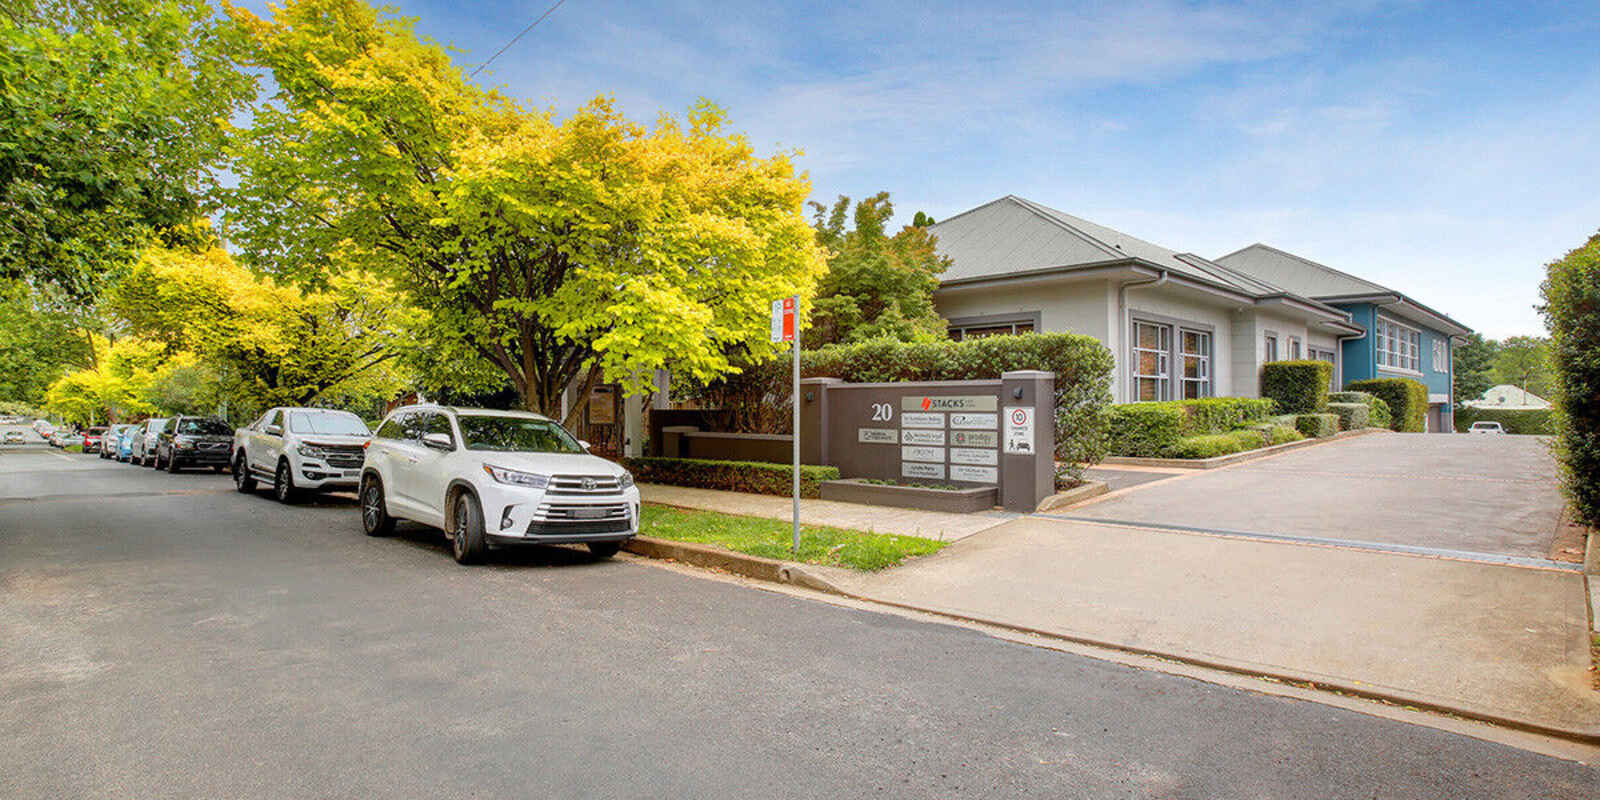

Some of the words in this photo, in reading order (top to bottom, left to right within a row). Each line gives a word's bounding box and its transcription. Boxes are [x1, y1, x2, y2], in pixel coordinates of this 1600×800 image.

[932, 399, 965, 408] STACKS
[871, 403, 893, 422] 20
[1015, 412, 1023, 421] 10
